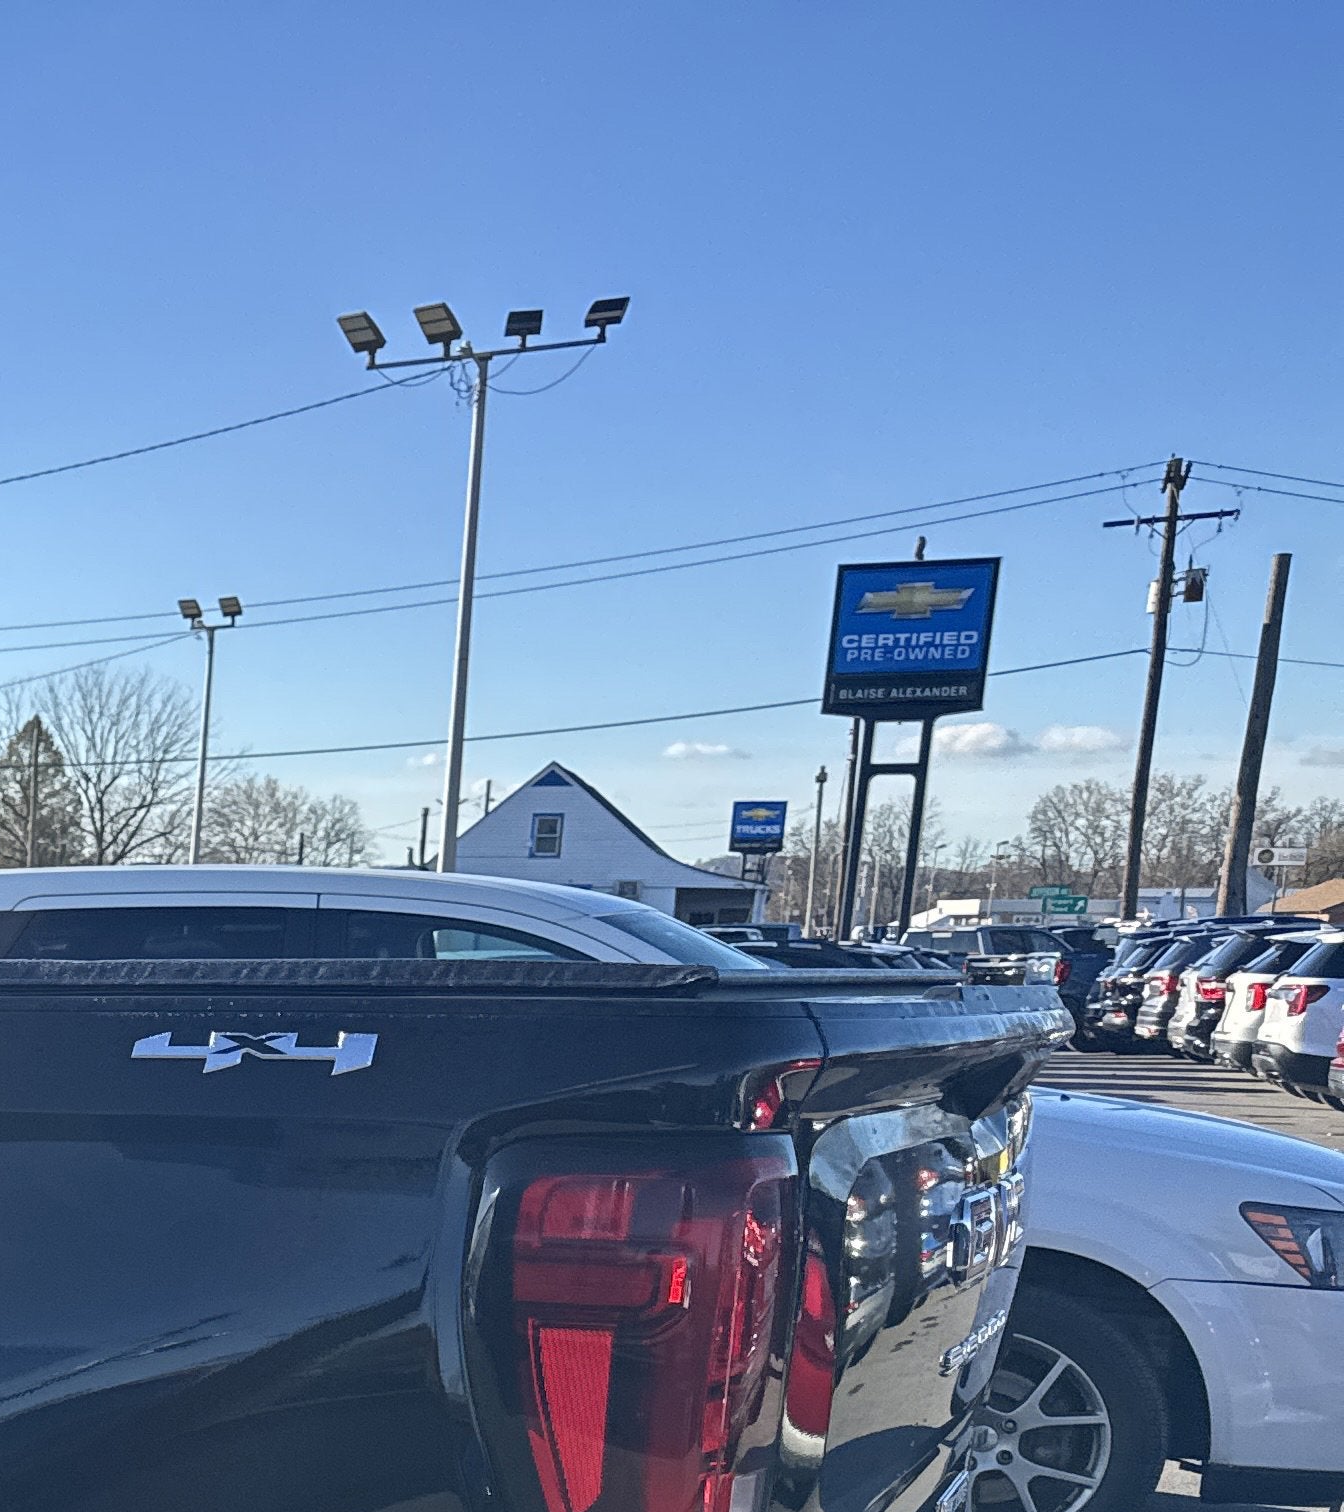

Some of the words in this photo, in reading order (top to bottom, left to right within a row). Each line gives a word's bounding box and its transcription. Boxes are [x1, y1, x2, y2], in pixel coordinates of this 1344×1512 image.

[841, 630, 979, 648] CERTIFIED
[845, 645, 971, 662] PRE-OWNED
[838, 687, 886, 700] BLAISE
[889, 685, 969, 699] ALEXANDER
